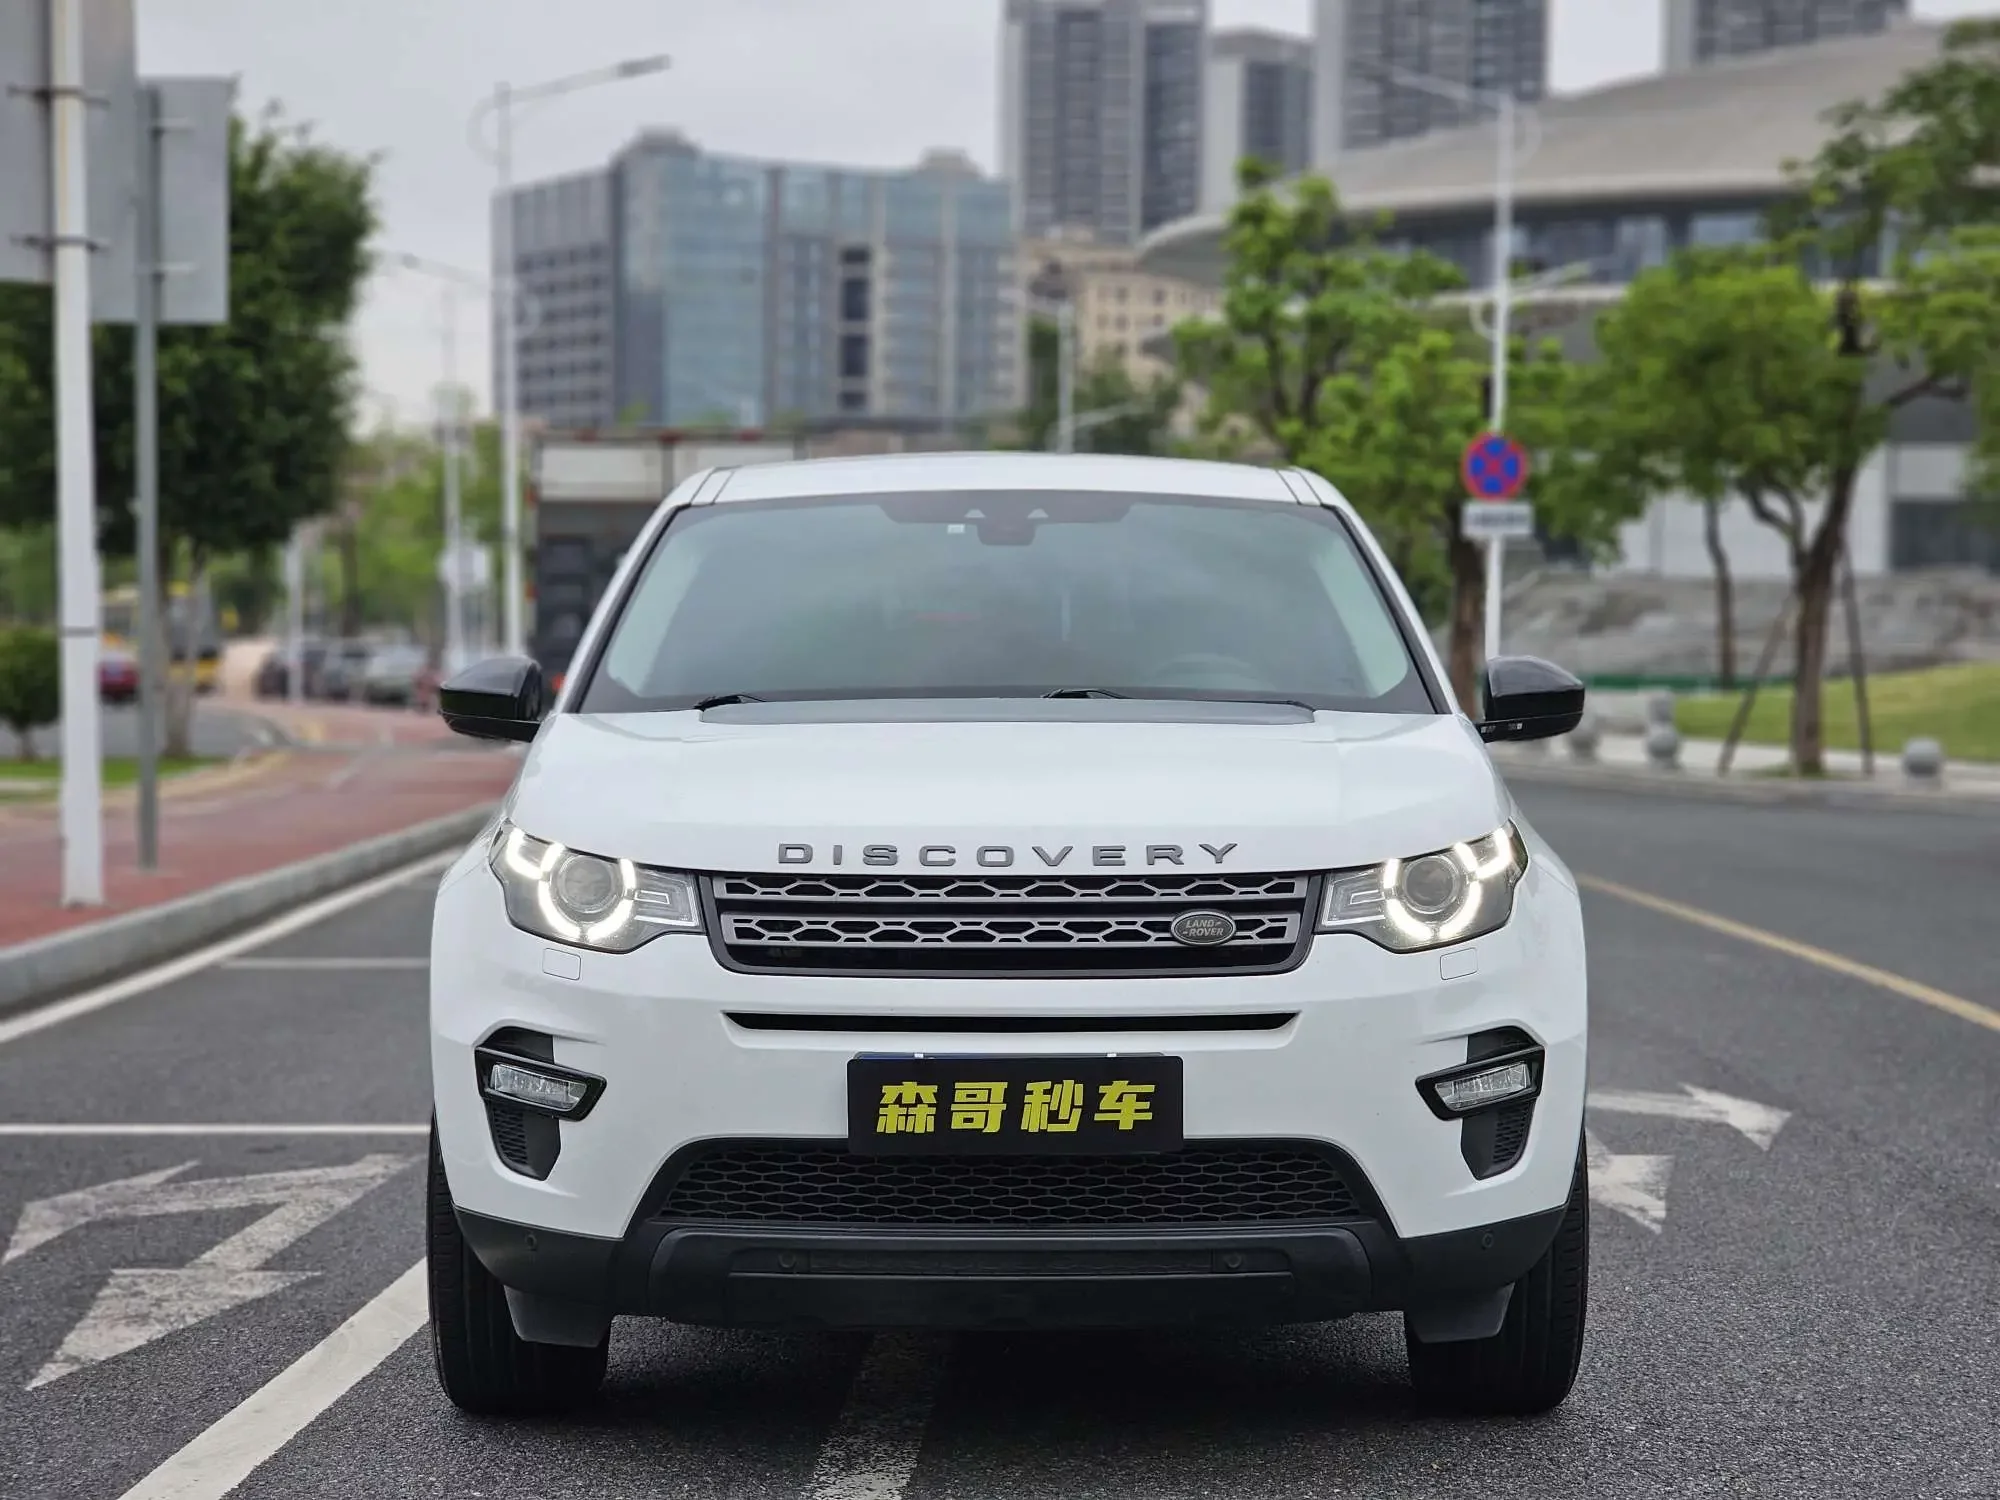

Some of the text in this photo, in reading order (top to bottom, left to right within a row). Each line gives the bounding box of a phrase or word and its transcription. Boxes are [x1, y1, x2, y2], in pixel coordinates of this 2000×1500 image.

[778, 843, 1238, 867] DISCOVERY
[1185, 919, 1215, 928] LAND
[876, 1079, 1156, 1134] 森哥秒车
